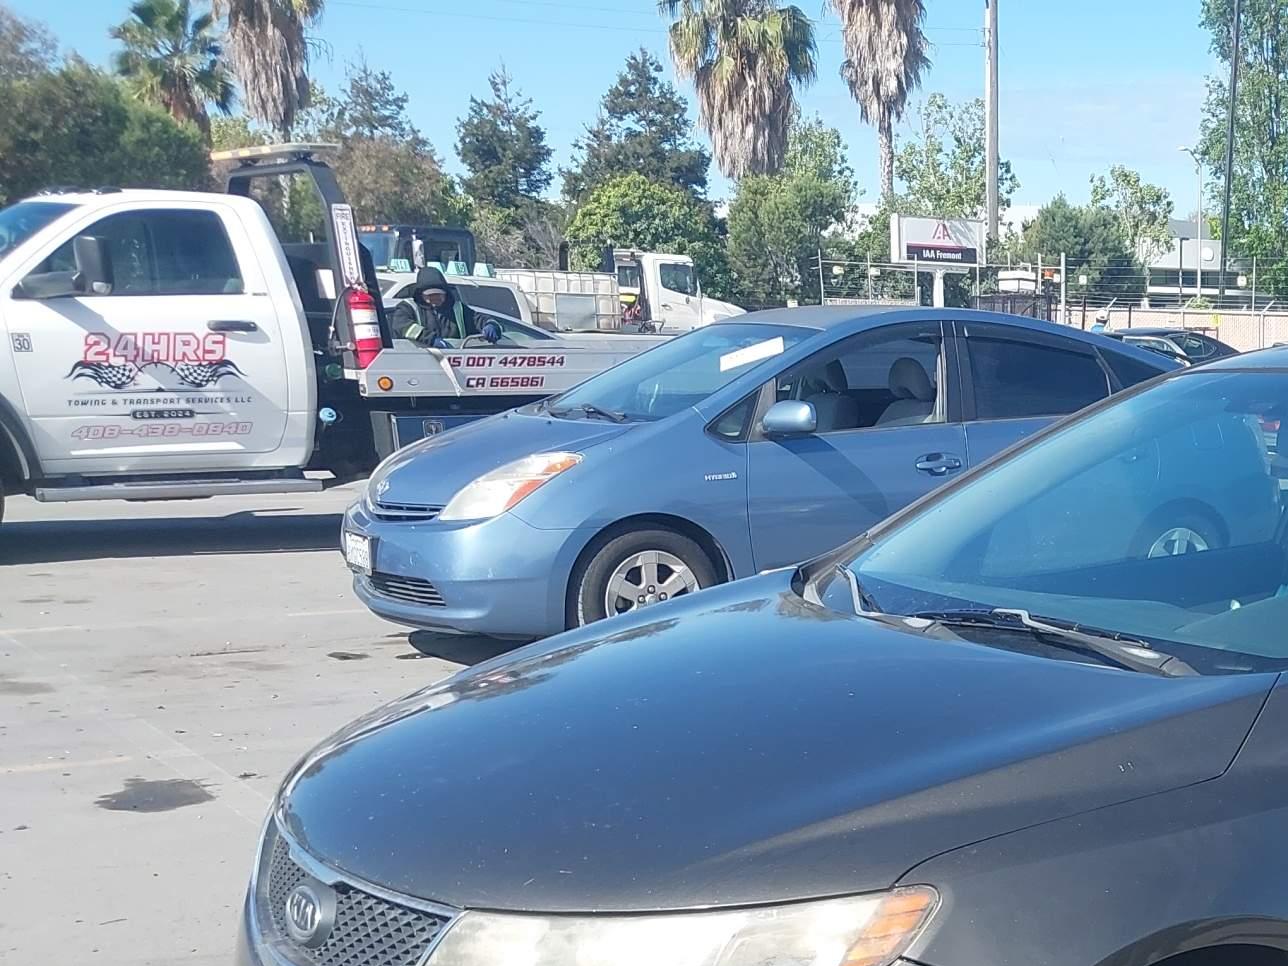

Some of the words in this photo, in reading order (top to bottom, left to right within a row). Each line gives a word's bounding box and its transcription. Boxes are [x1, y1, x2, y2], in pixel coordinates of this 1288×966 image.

[922, 249, 935, 259] IAA
[936, 250, 962, 260] Fremont
[14, 338, 30, 350] 30
[84, 332, 227, 364] 24HRS
[498, 356, 566, 367] 4478544
[466, 377, 486, 388] CA
[489, 376, 544, 388] 665861
[67, 399, 107, 407] TOWING
[123, 398, 180, 406] TRANSPORT
[185, 396, 232, 404] SERVICES
[71, 422, 253, 440] 408-438-0840
